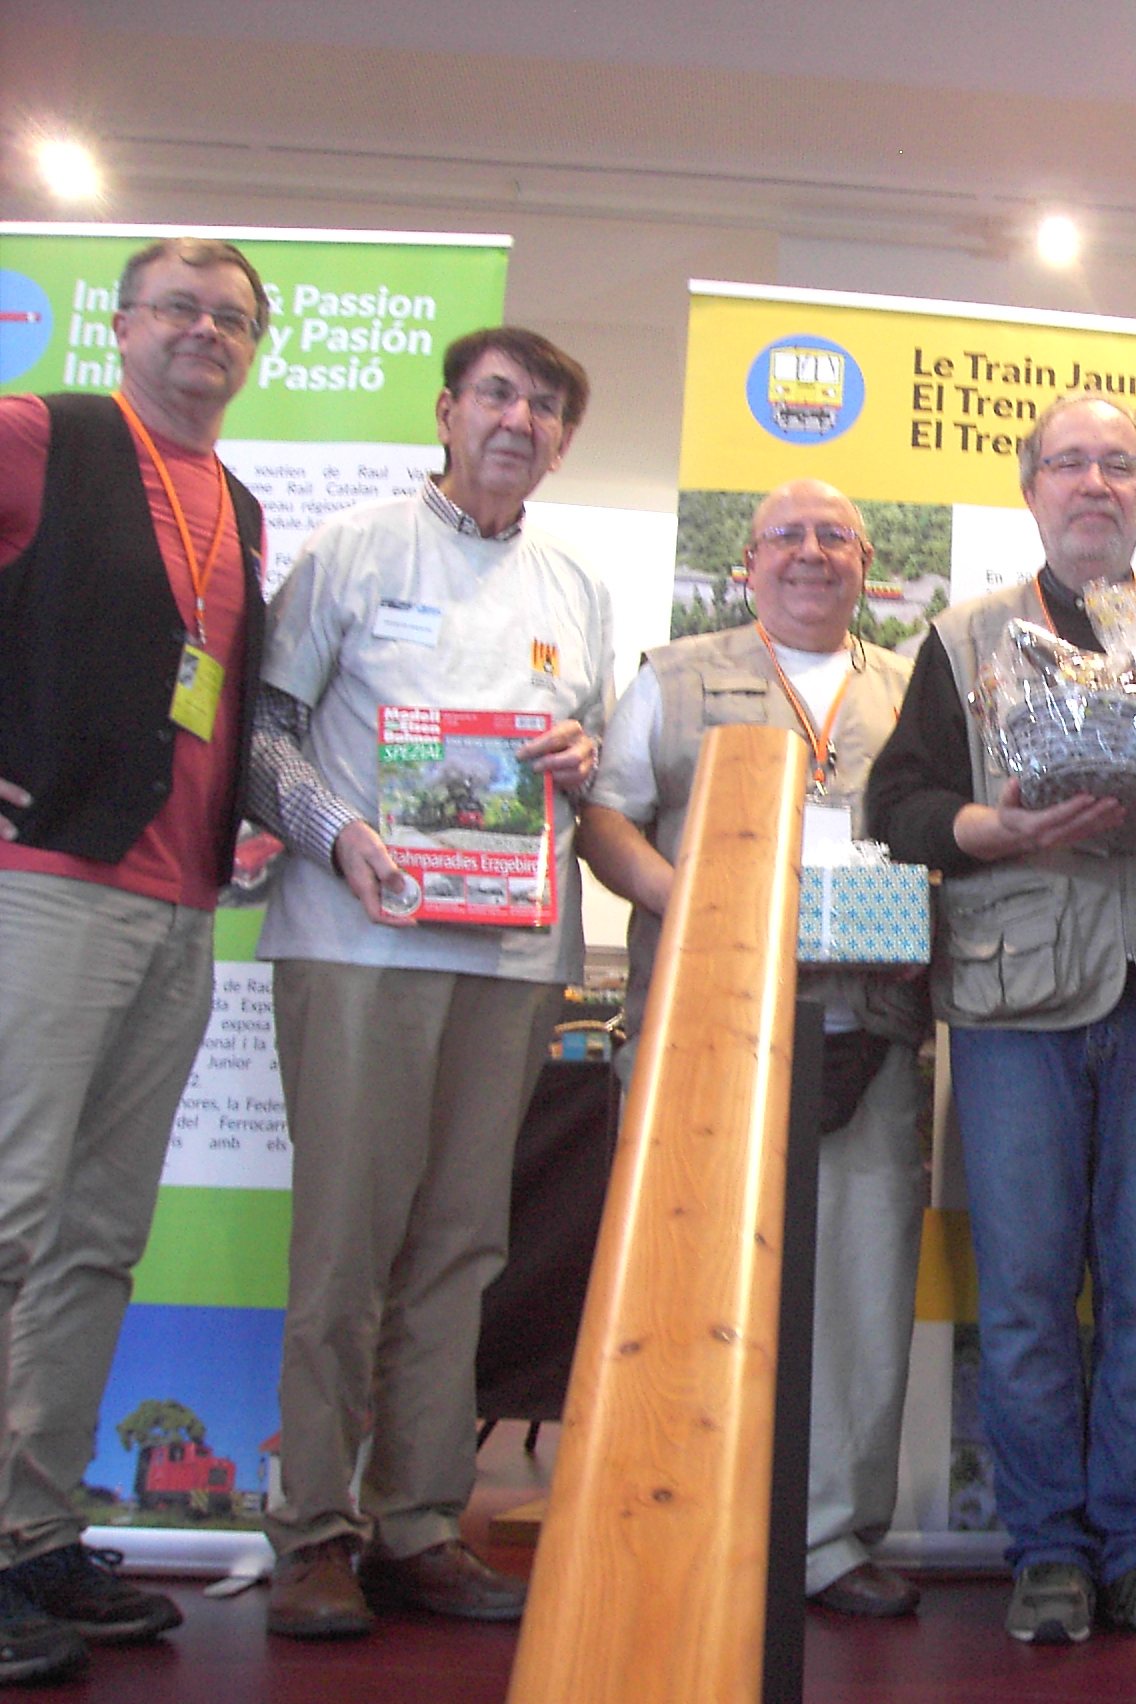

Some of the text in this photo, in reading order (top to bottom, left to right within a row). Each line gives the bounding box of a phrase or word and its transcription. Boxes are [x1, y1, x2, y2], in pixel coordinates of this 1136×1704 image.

[293, 285, 436, 321] Passion
[269, 324, 293, 358] y
[301, 317, 433, 356] Pasión
[258, 354, 386, 392] Passió
[914, 347, 955, 378] Le
[963, 349, 1057, 388] Train
[912, 383, 944, 413] El
[954, 385, 1037, 421] Tren
[911, 419, 943, 451] El
